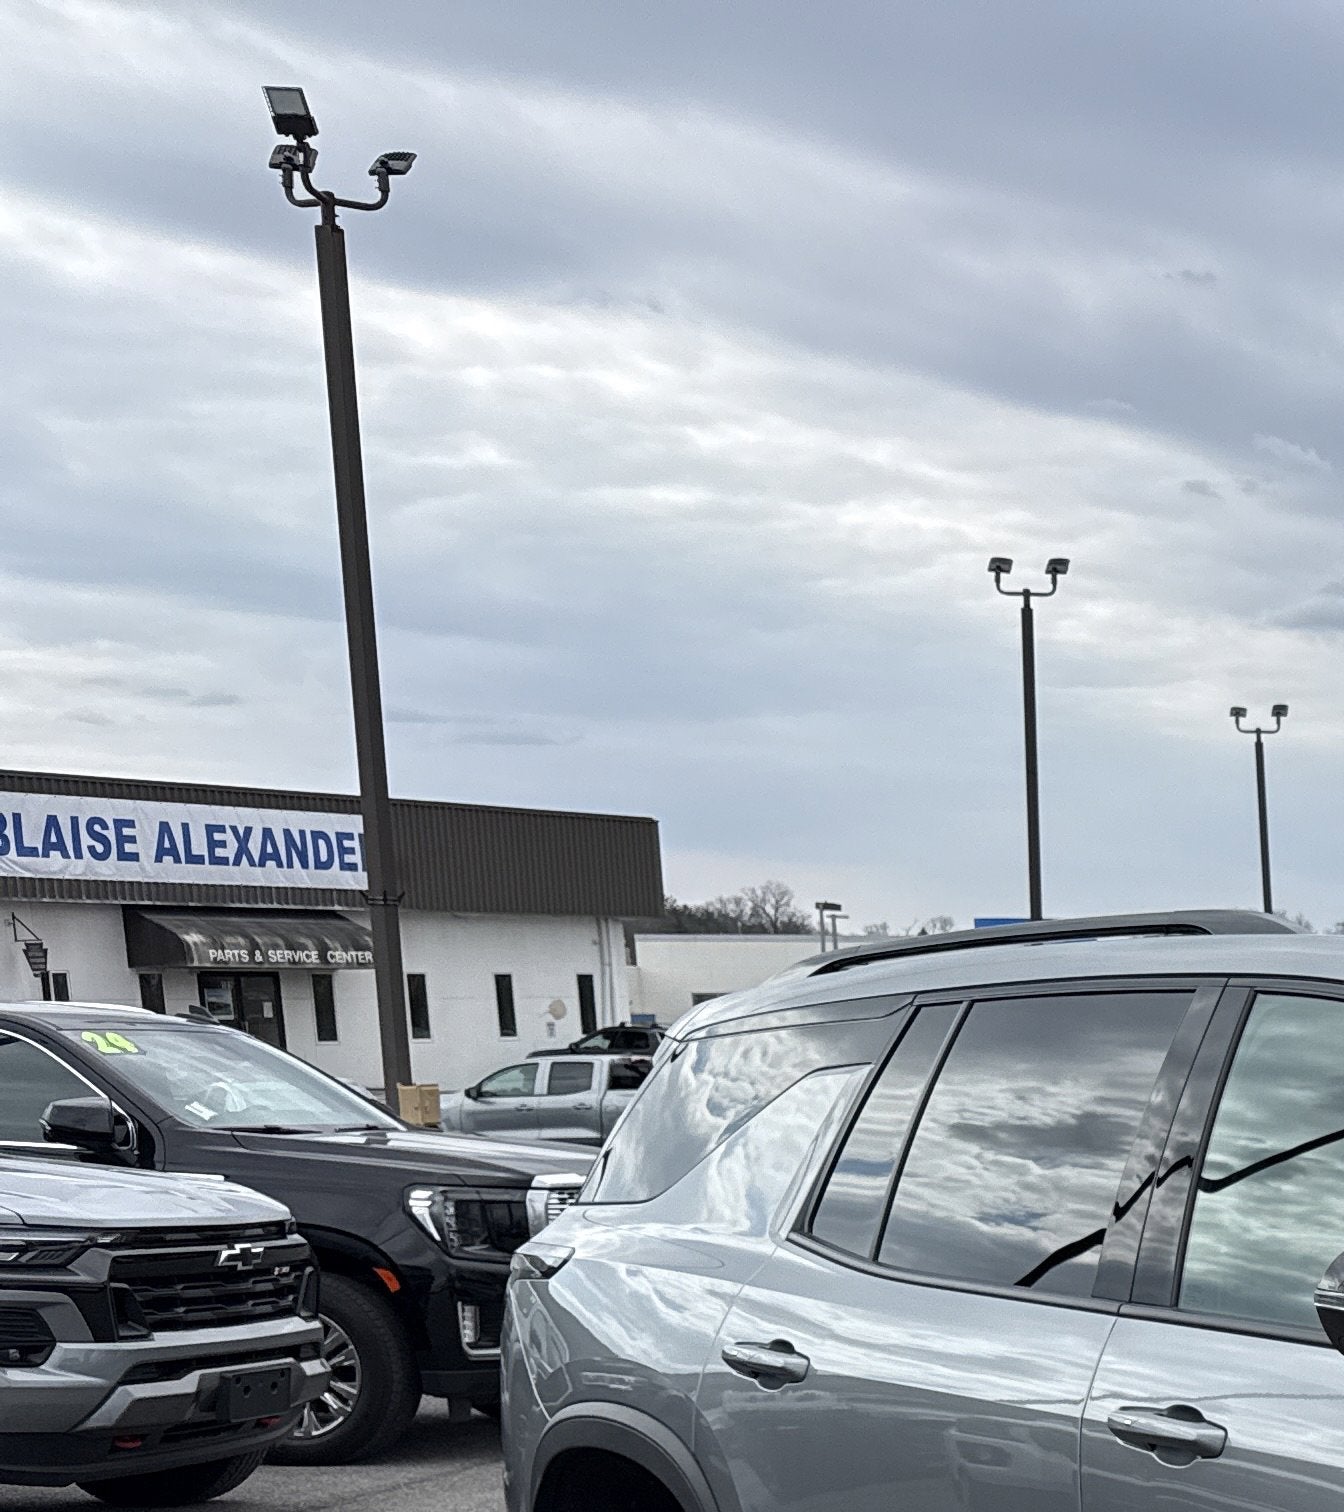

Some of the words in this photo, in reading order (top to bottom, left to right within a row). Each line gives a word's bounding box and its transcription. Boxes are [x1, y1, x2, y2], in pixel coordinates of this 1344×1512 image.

[209, 949, 250, 962] PARTS
[254, 950, 264, 962] &
[268, 950, 320, 963] SERVICE
[327, 951, 374, 963] CENTER
